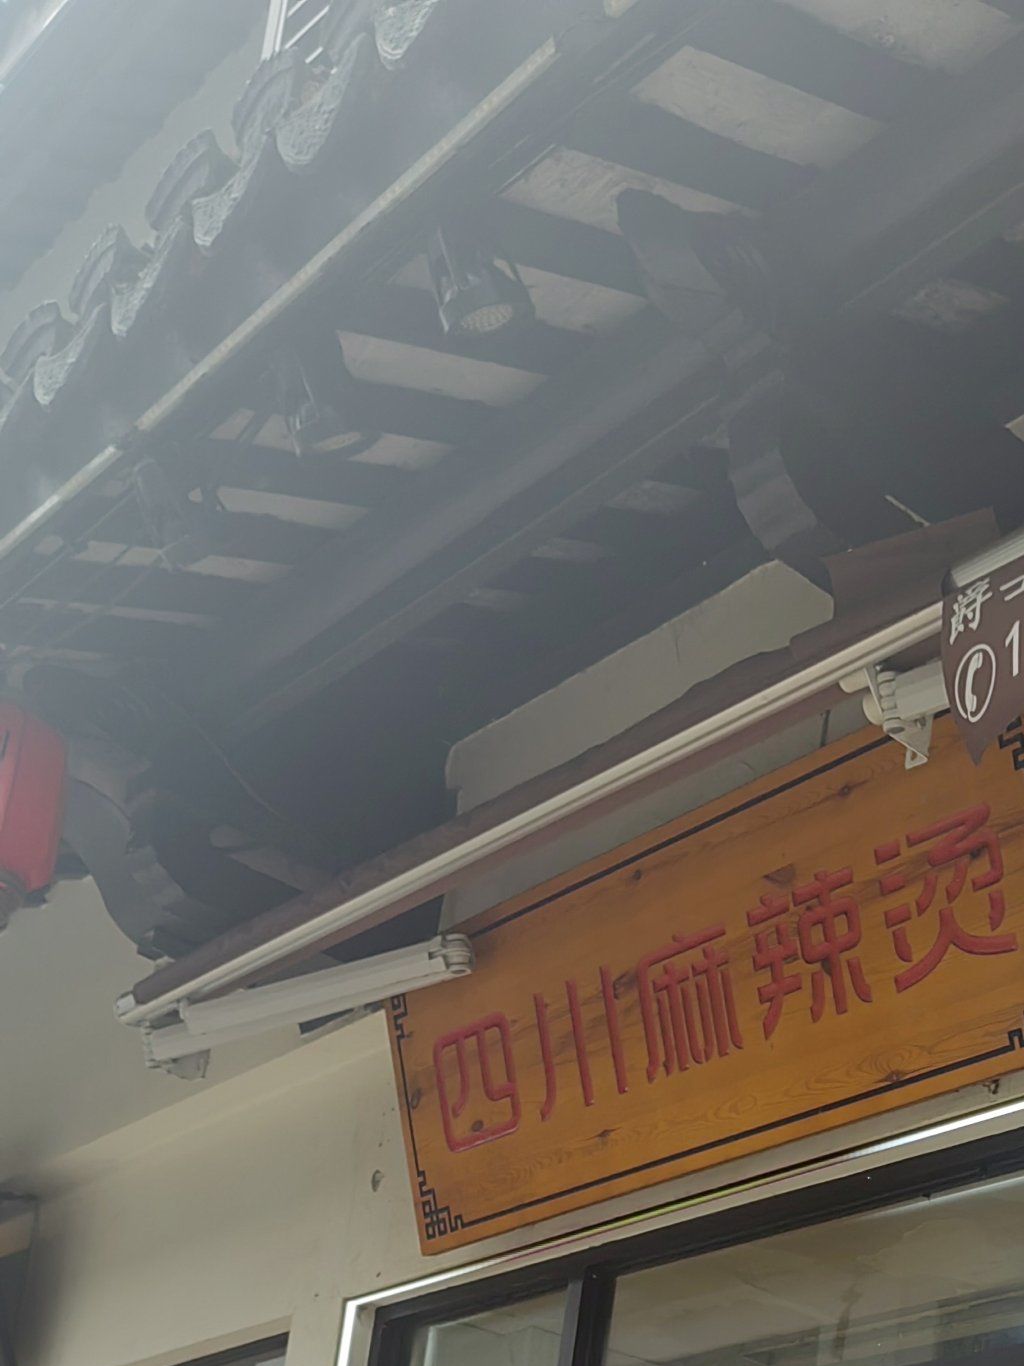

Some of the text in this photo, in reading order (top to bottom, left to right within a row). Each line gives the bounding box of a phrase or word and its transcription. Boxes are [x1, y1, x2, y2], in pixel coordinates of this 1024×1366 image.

[432, 803, 1017, 1152] 四川麻辣烫
